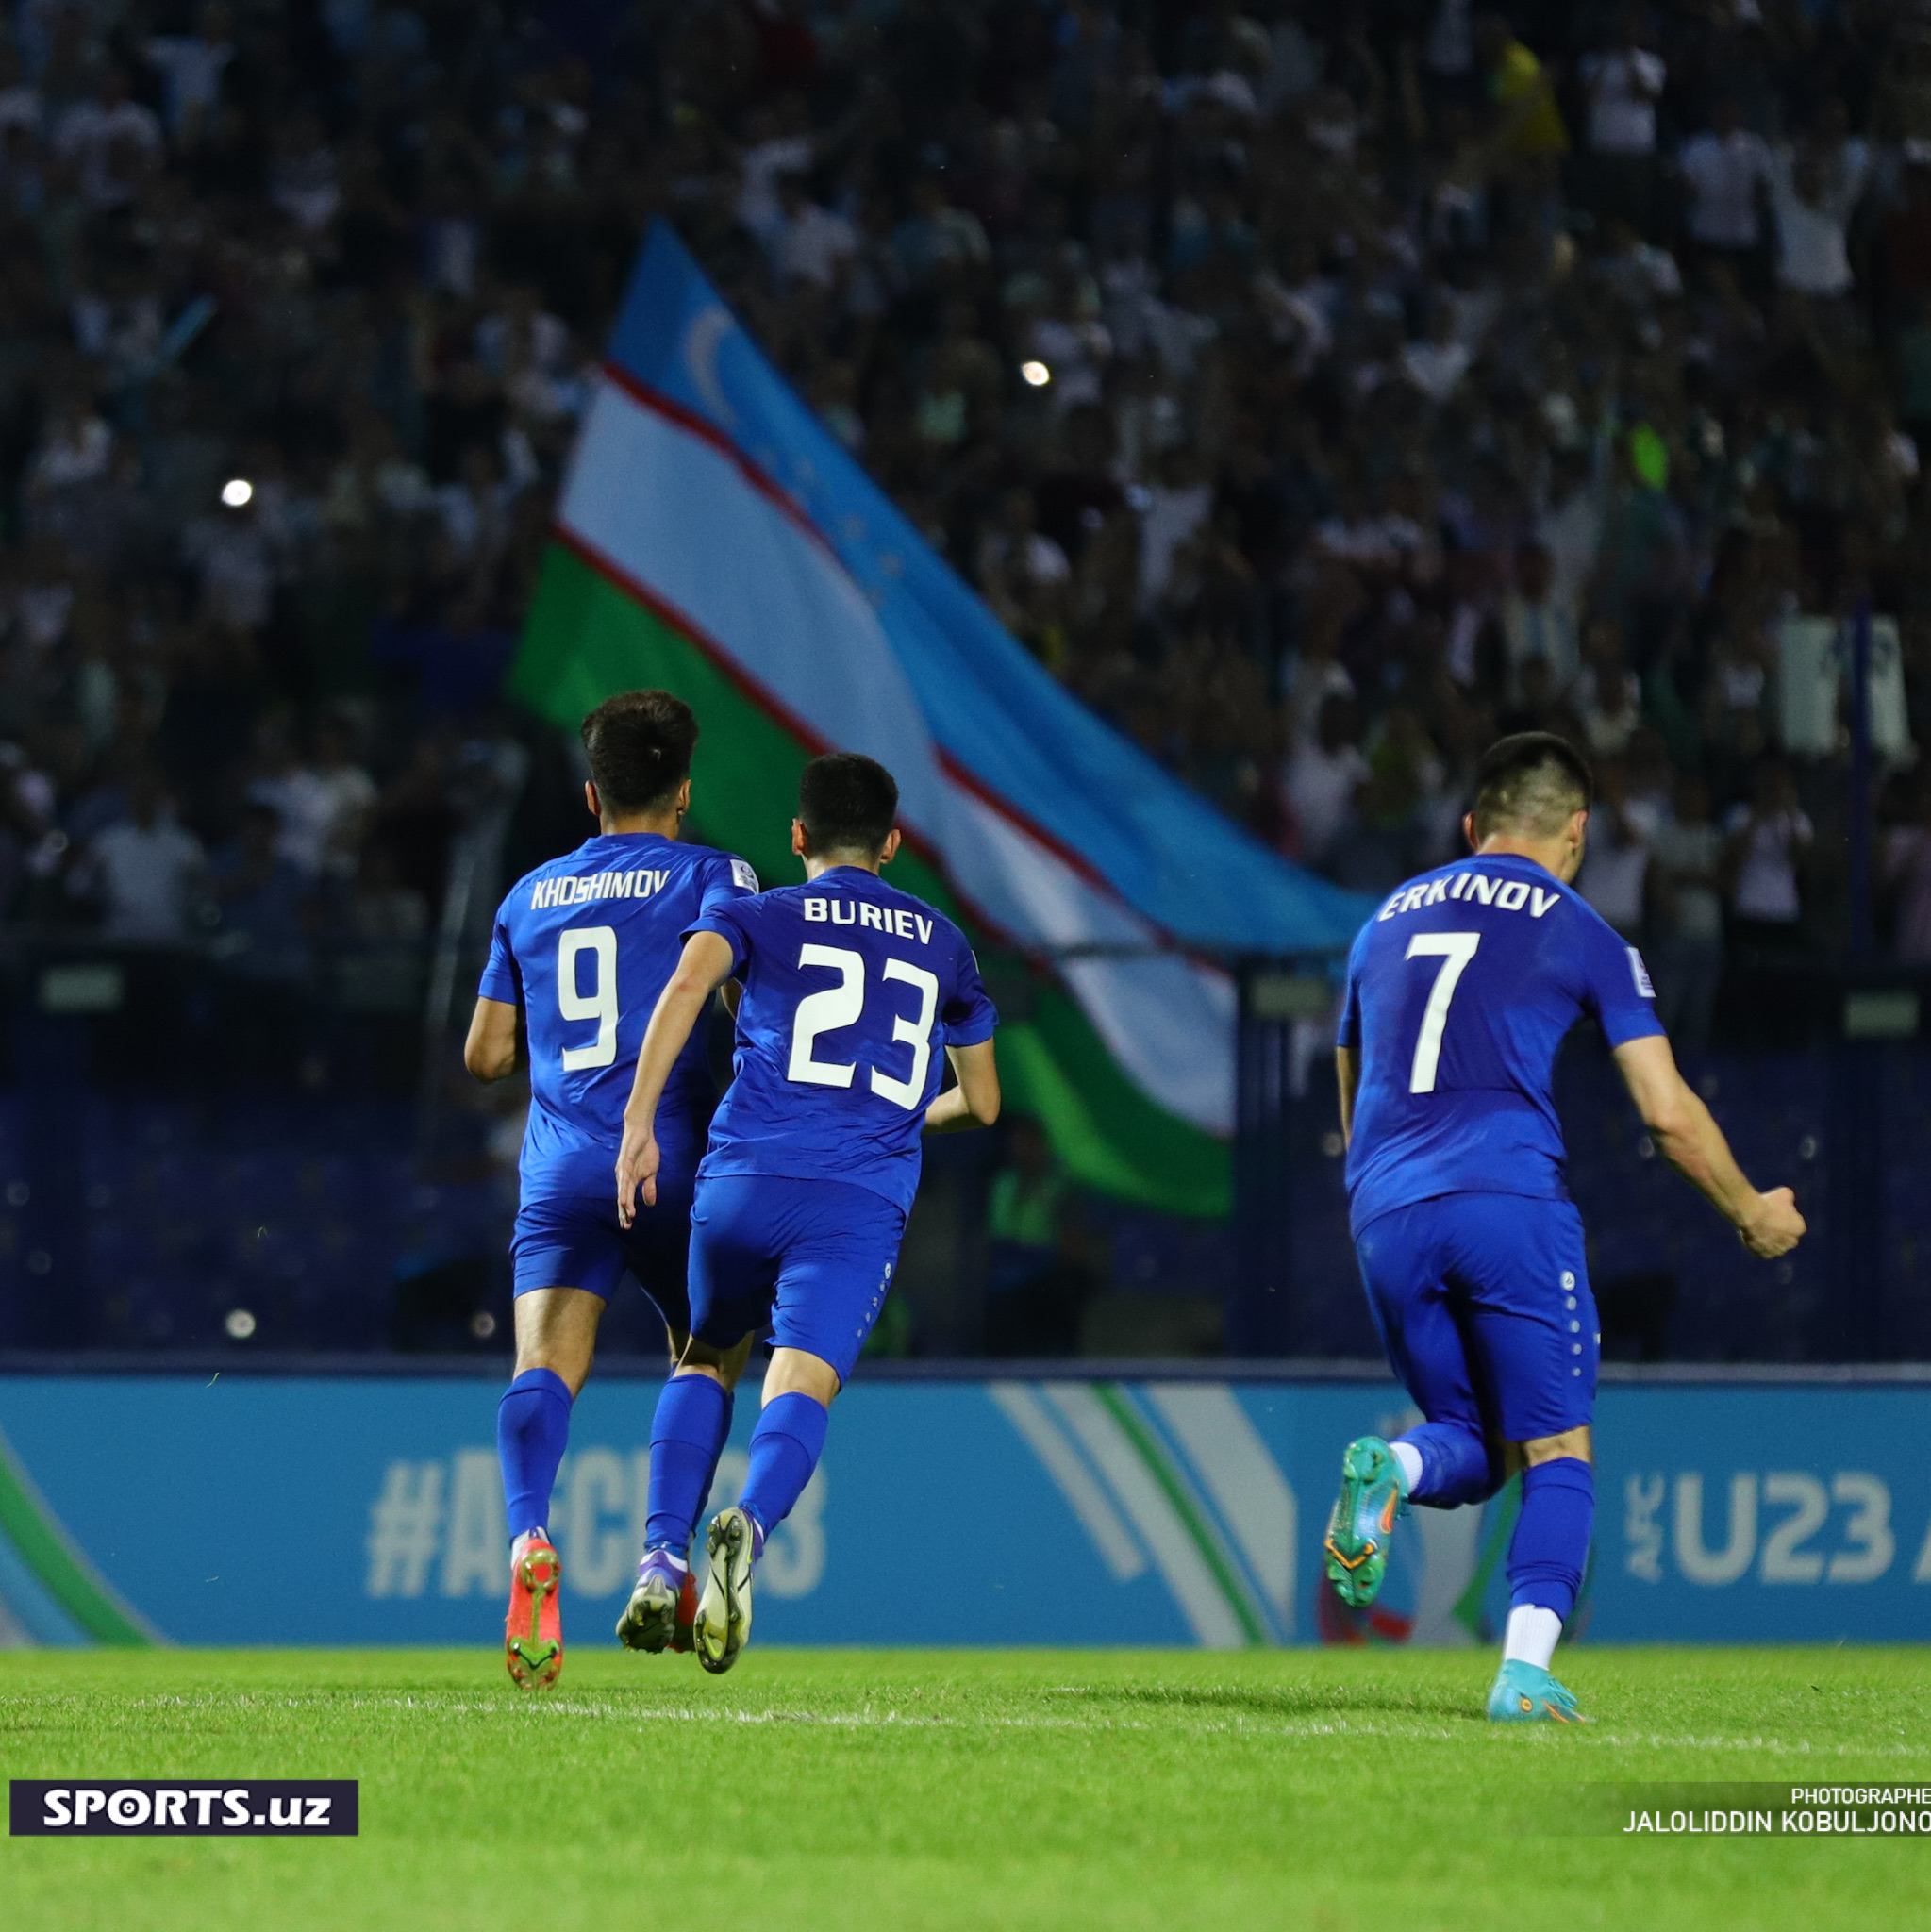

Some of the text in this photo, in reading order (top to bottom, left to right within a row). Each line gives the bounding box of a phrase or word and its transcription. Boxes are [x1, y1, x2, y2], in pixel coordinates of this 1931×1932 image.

[529, 869, 671, 911] KHOSHIMOV
[802, 897, 934, 945] BURIEV
[1376, 872, 1561, 923] ERKINOV
[557, 925, 619, 1073] 9
[787, 943, 940, 1111] 23
[1404, 931, 1482, 1095] 7
[1673, 1472, 1896, 1586] U23
